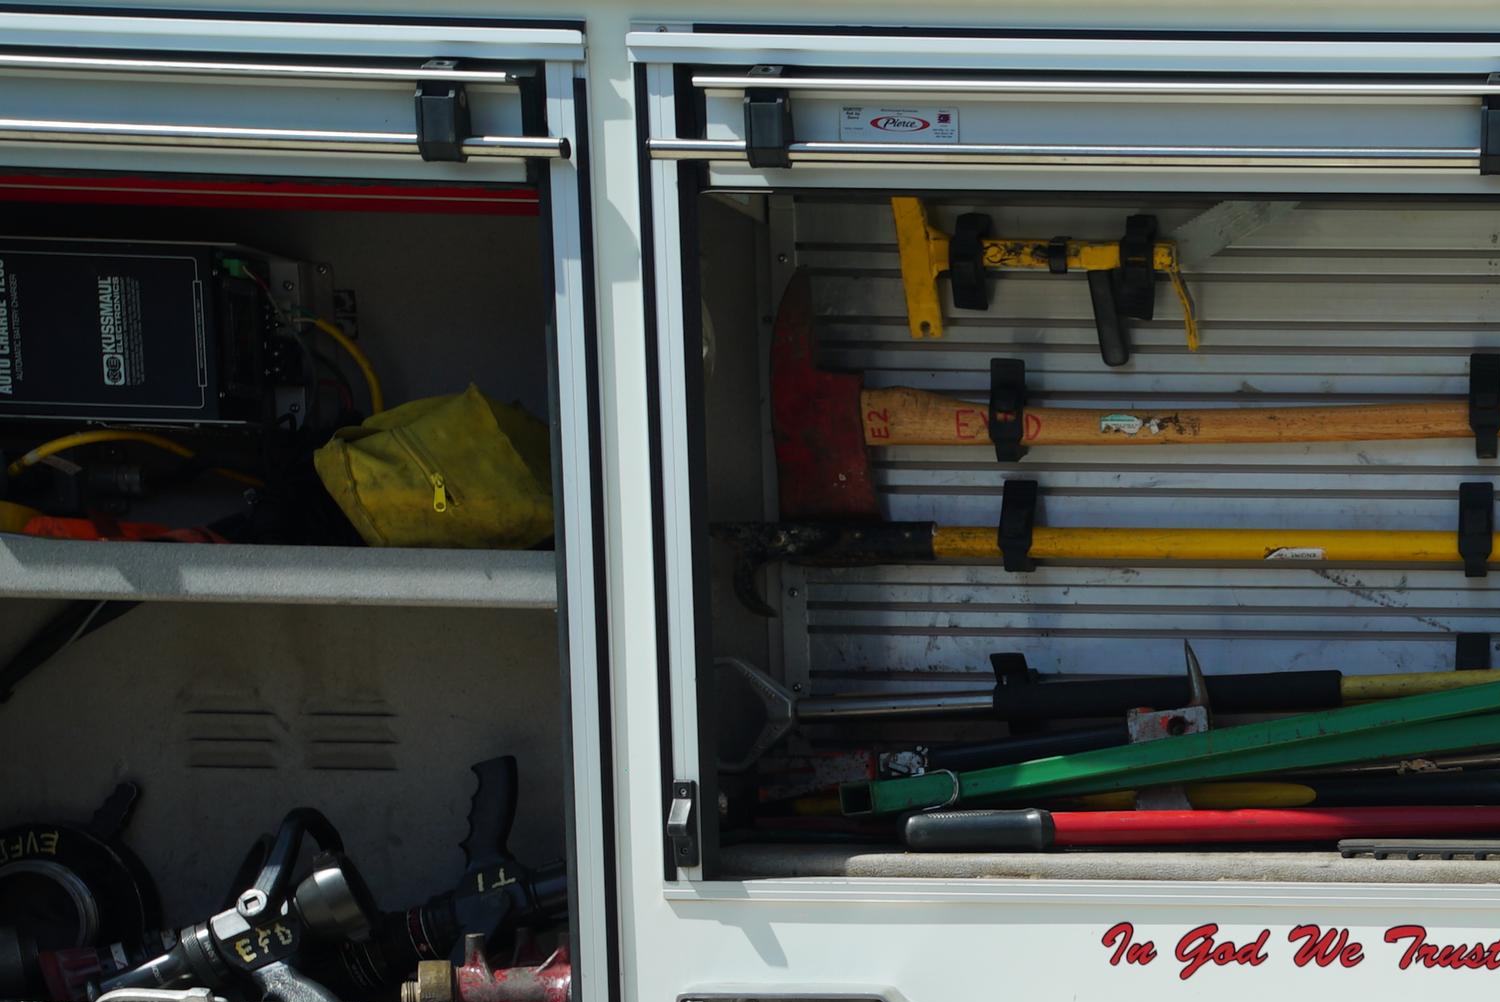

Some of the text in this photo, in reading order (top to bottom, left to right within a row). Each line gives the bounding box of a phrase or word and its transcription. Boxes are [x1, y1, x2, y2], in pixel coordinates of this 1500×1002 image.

[883, 117, 917, 129] Pierce
[9, 272, 23, 381] AUTOMATIC BATTERY CHARGER
[98, 276, 115, 353] KUSSMAUL
[112, 276, 123, 353] ELECTRONICS
[866, 407, 891, 440] E2
[955, 408, 1042, 442] ED
[1101, 921, 1157, 967] In
[1174, 923, 1271, 981] God
[1287, 923, 1365, 968] We
